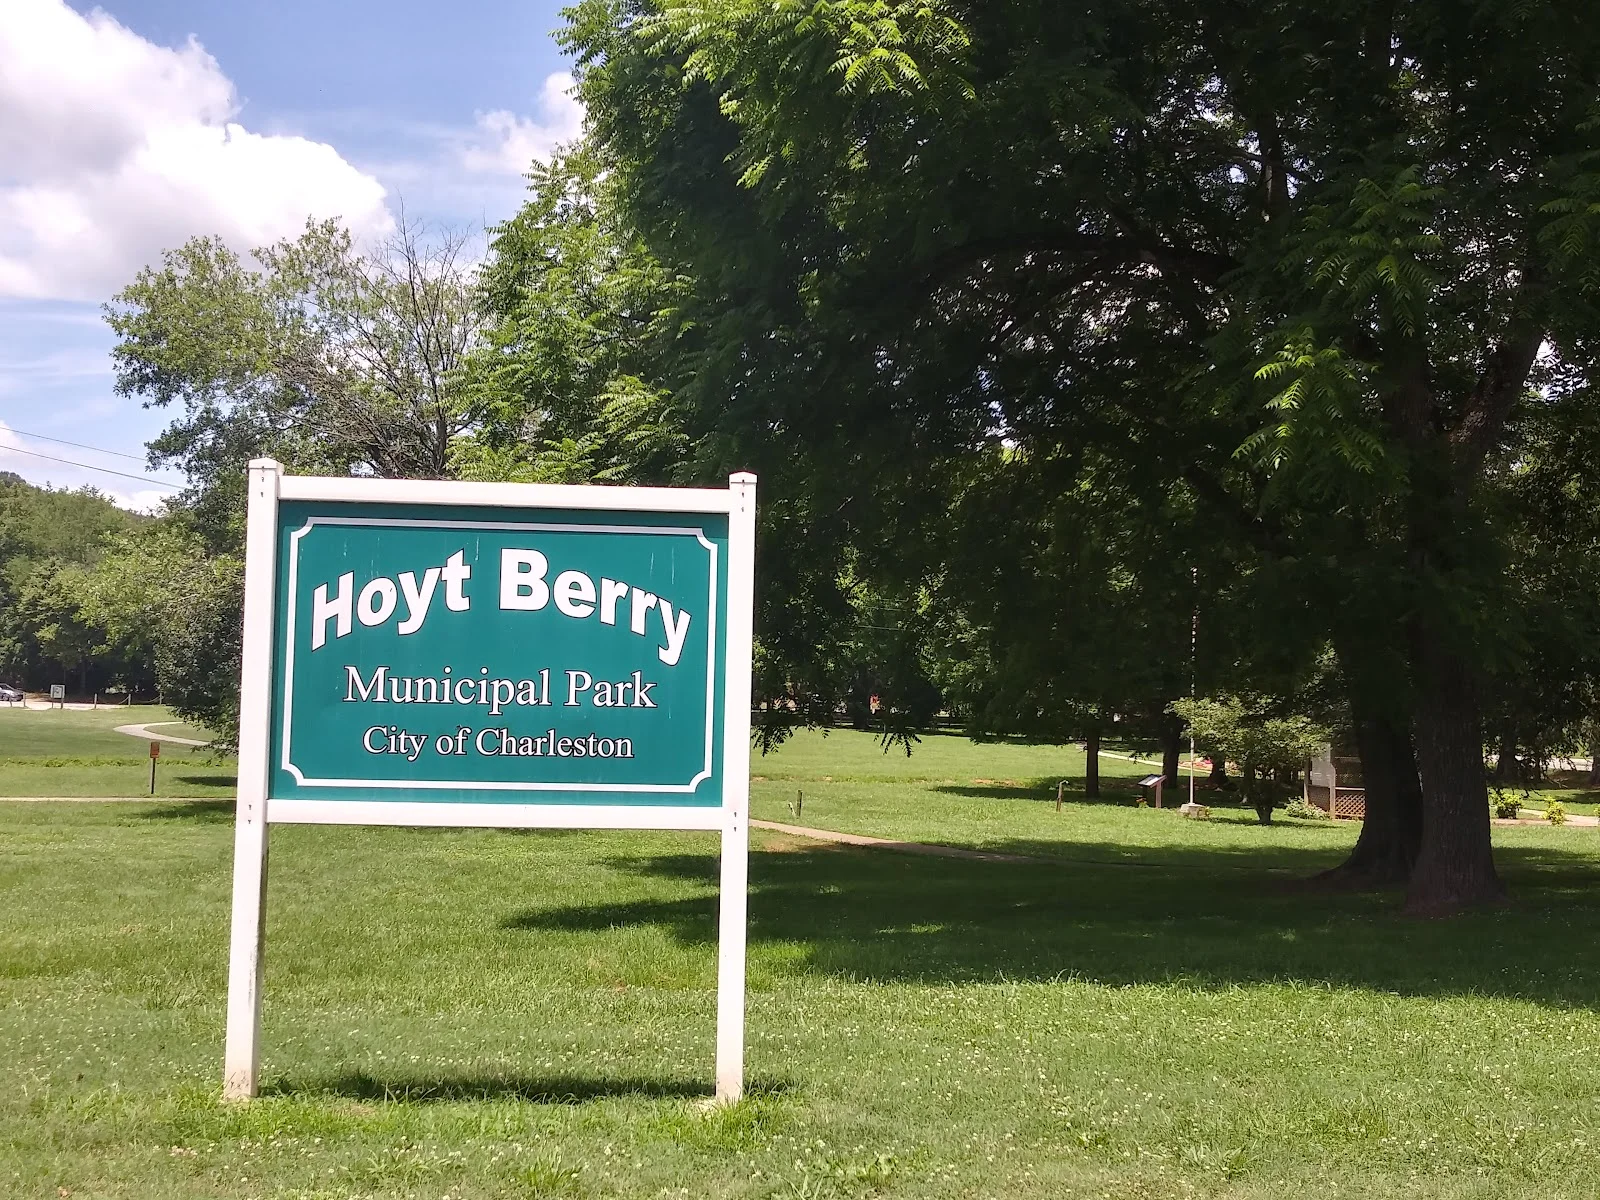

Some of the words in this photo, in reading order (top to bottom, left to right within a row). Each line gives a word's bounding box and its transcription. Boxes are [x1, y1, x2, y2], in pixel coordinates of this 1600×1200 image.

[311, 548, 472, 652] Hoyt
[499, 548, 692, 666] Berry
[343, 665, 552, 715] Municipal
[564, 669, 658, 709] Park
[363, 725, 428, 762] City
[436, 726, 472, 756] of
[475, 727, 634, 759] Charleston
